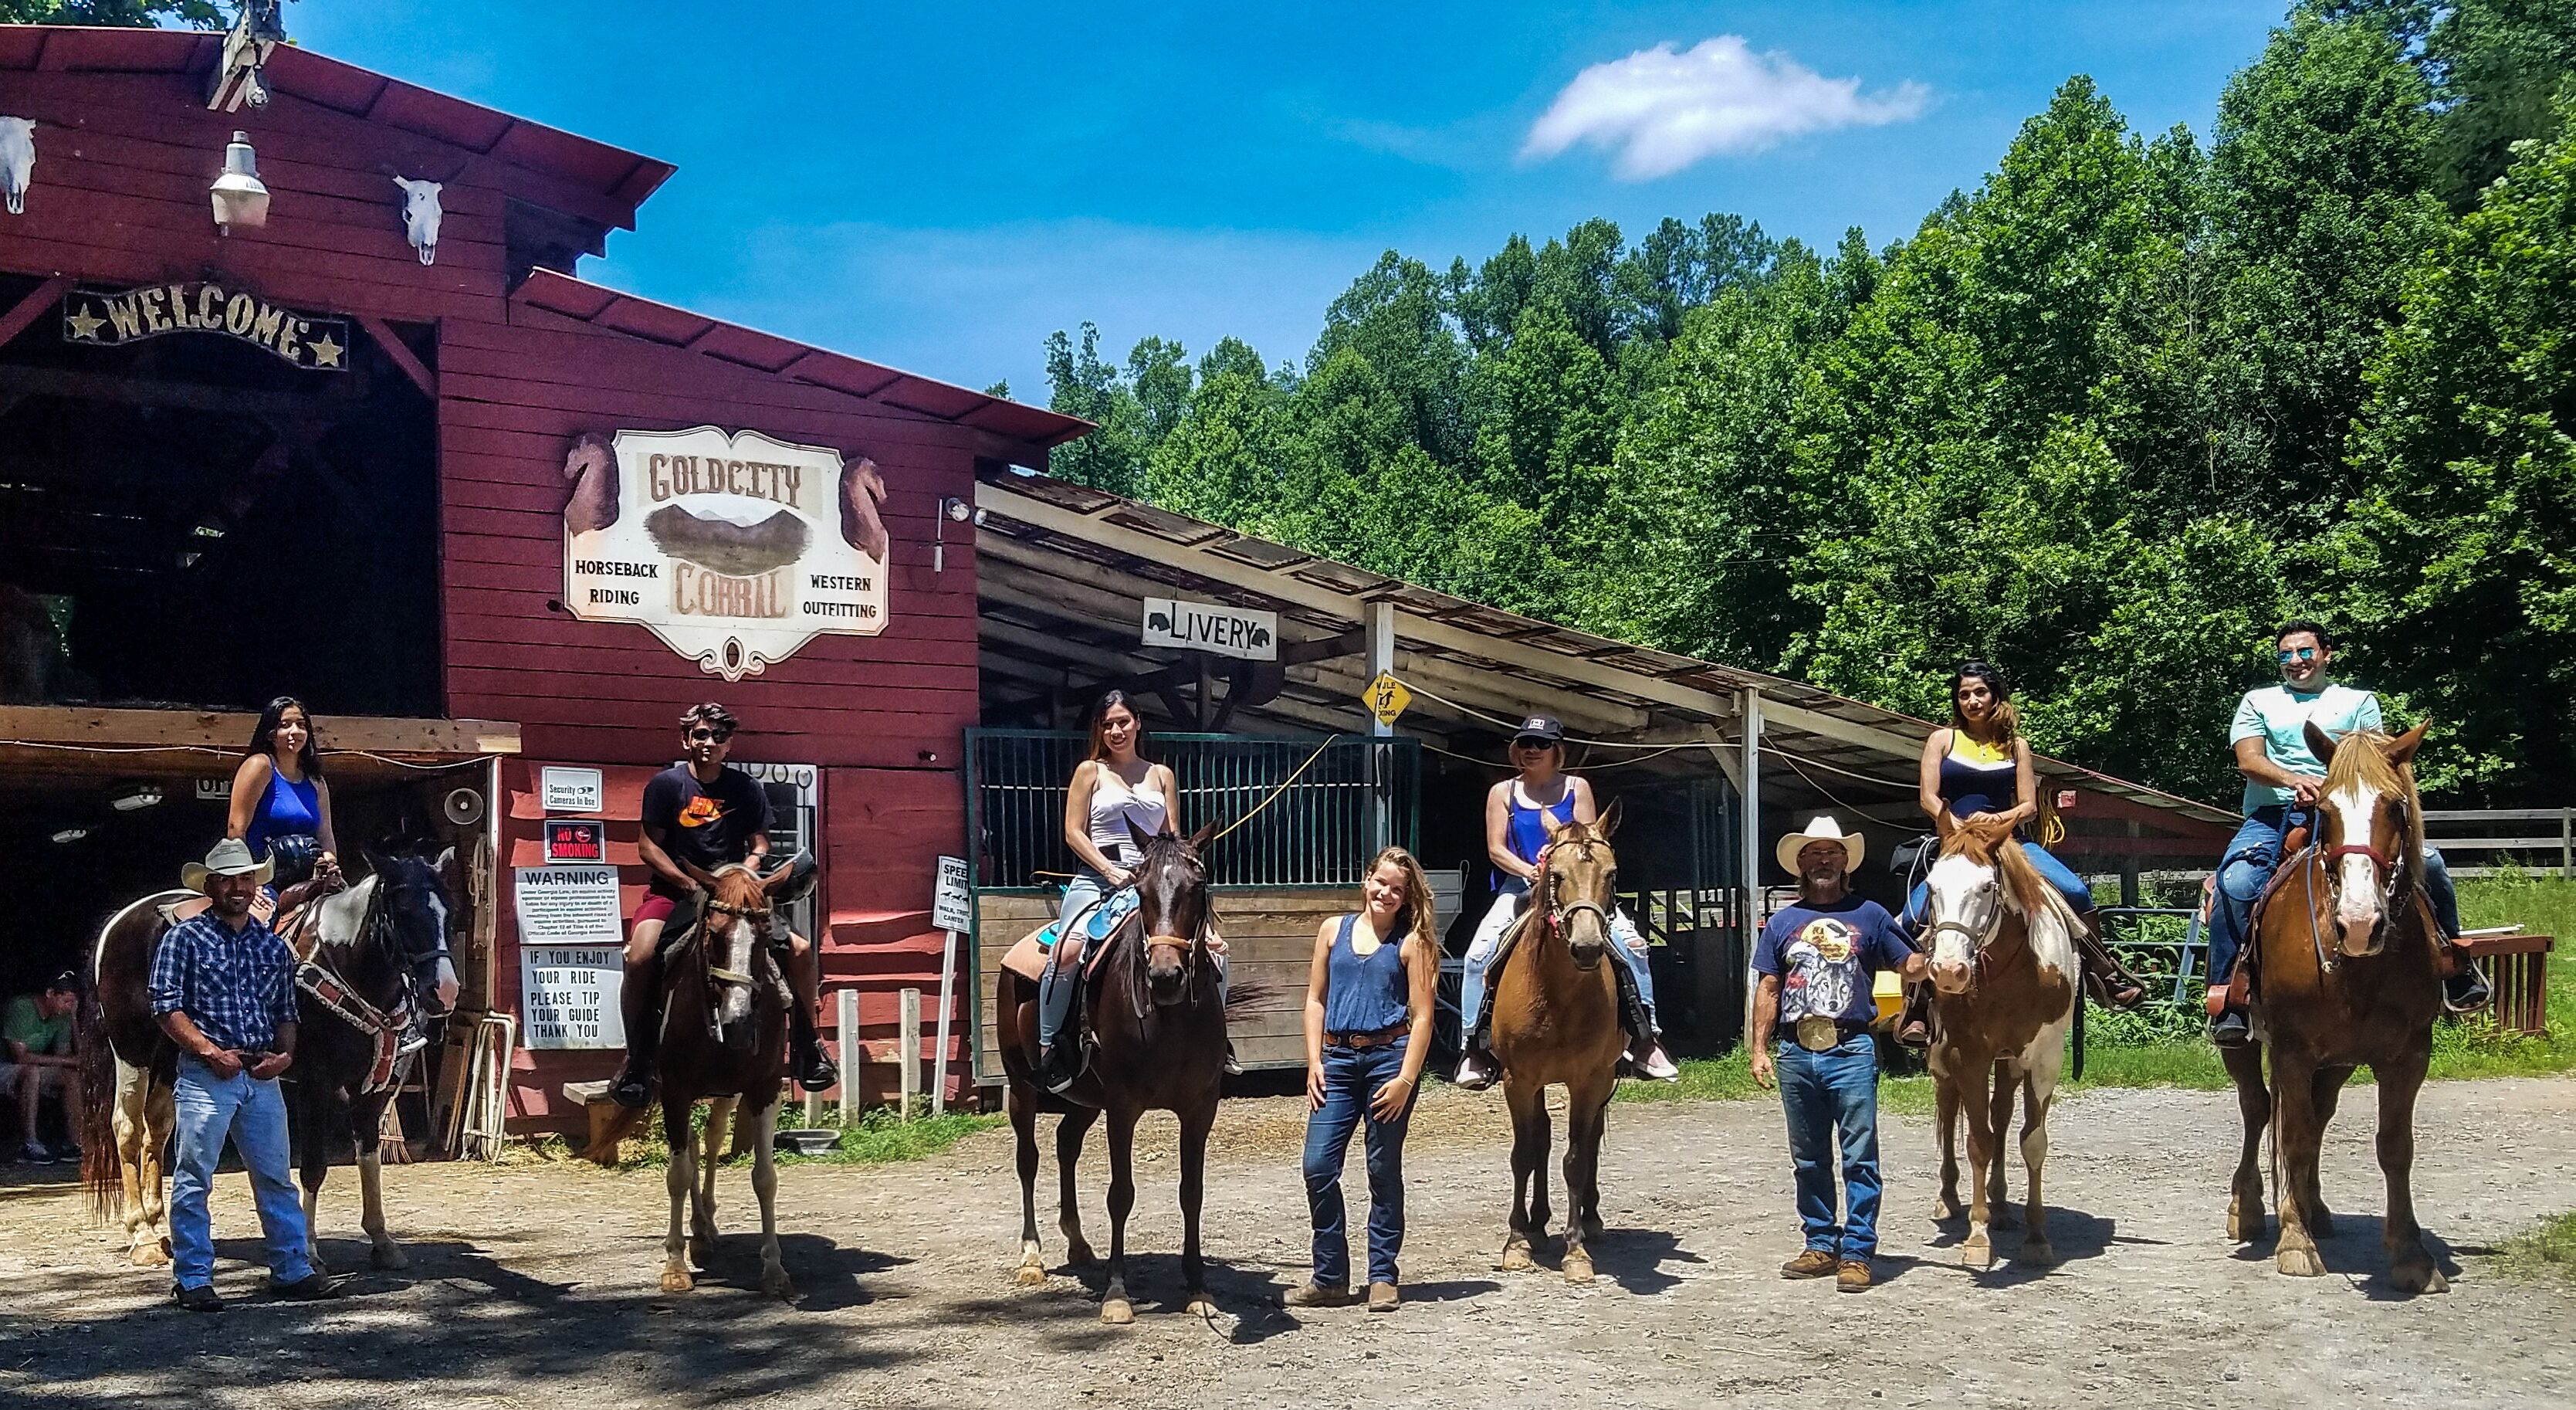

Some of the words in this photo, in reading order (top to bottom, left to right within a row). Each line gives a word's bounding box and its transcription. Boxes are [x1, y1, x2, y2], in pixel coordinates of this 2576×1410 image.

[102, 284, 310, 361] WELCOME
[575, 560, 658, 578] HORSEBACK
[810, 574, 872, 591] WESTERN
[590, 588, 640, 605] RIDING
[675, 562, 787, 619] CORRAL
[803, 601, 877, 619] OUTFITTING
[1170, 602, 1258, 650] LIVERY
[549, 784, 576, 795] Security
[549, 795, 575, 805] Cameras
[577, 796, 584, 805] In
[584, 797, 595, 806] Use
[557, 826, 572, 842] NO
[551, 842, 599, 858] SMOKING
[525, 871, 609, 886] WARNING
[943, 864, 967, 878] SPEE
[946, 876, 969, 890] LIMIT
[943, 914, 964, 924] CANTER
[530, 951, 540, 964] IF
[548, 951, 570, 964] YOU
[576, 951, 610, 964] ENJOY
[532, 970, 560, 985] YOUR
[570, 971, 596, 985] RIDE
[530, 991, 573, 1006] PLEASE
[581, 991, 600, 1005] TIP
[531, 1008, 560, 1022] YOUR
[568, 1008, 600, 1022] GUIDE
[533, 1024, 569, 1038] THANK
[576, 1023, 598, 1038] YOU
